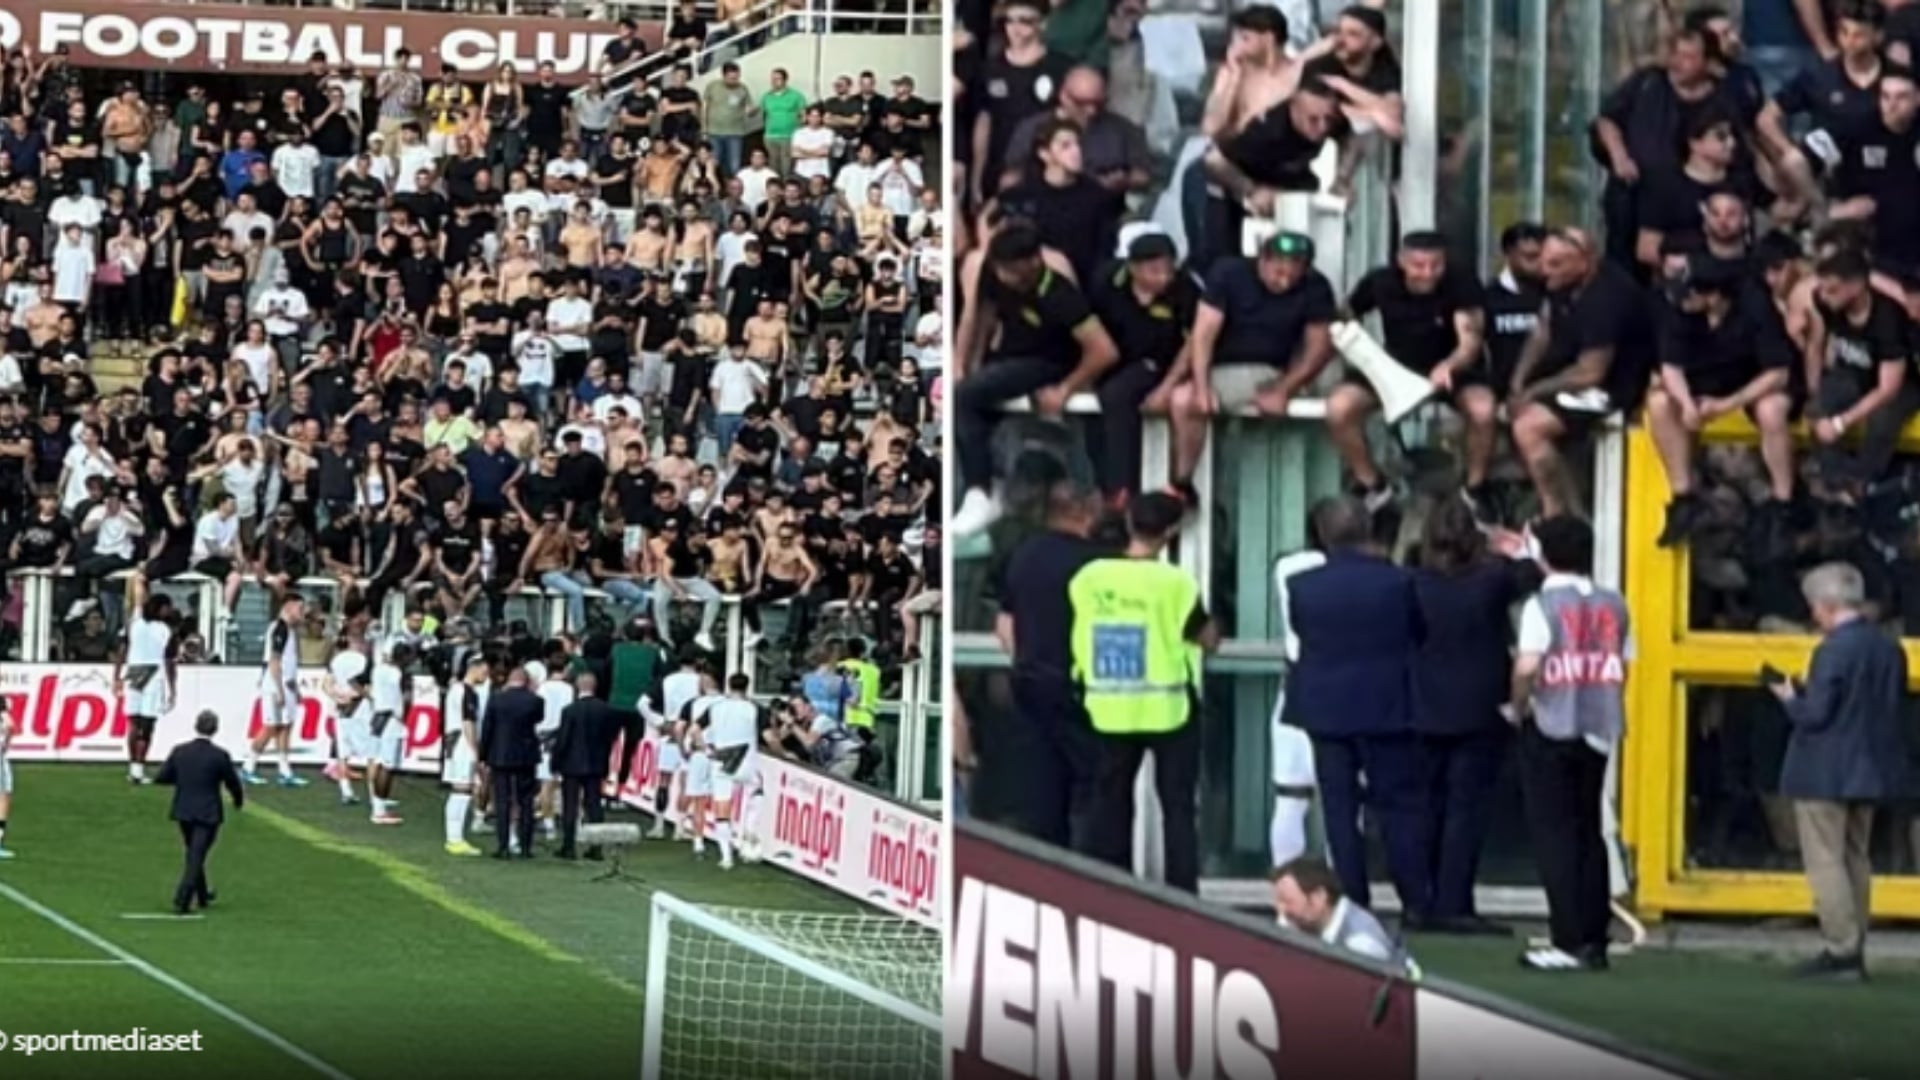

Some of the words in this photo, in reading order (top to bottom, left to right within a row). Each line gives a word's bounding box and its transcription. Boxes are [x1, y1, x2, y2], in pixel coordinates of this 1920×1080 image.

[40, 11, 422, 68] FOOTBALL
[775, 772, 844, 871] inalpi
[867, 808, 938, 909] inalpi
